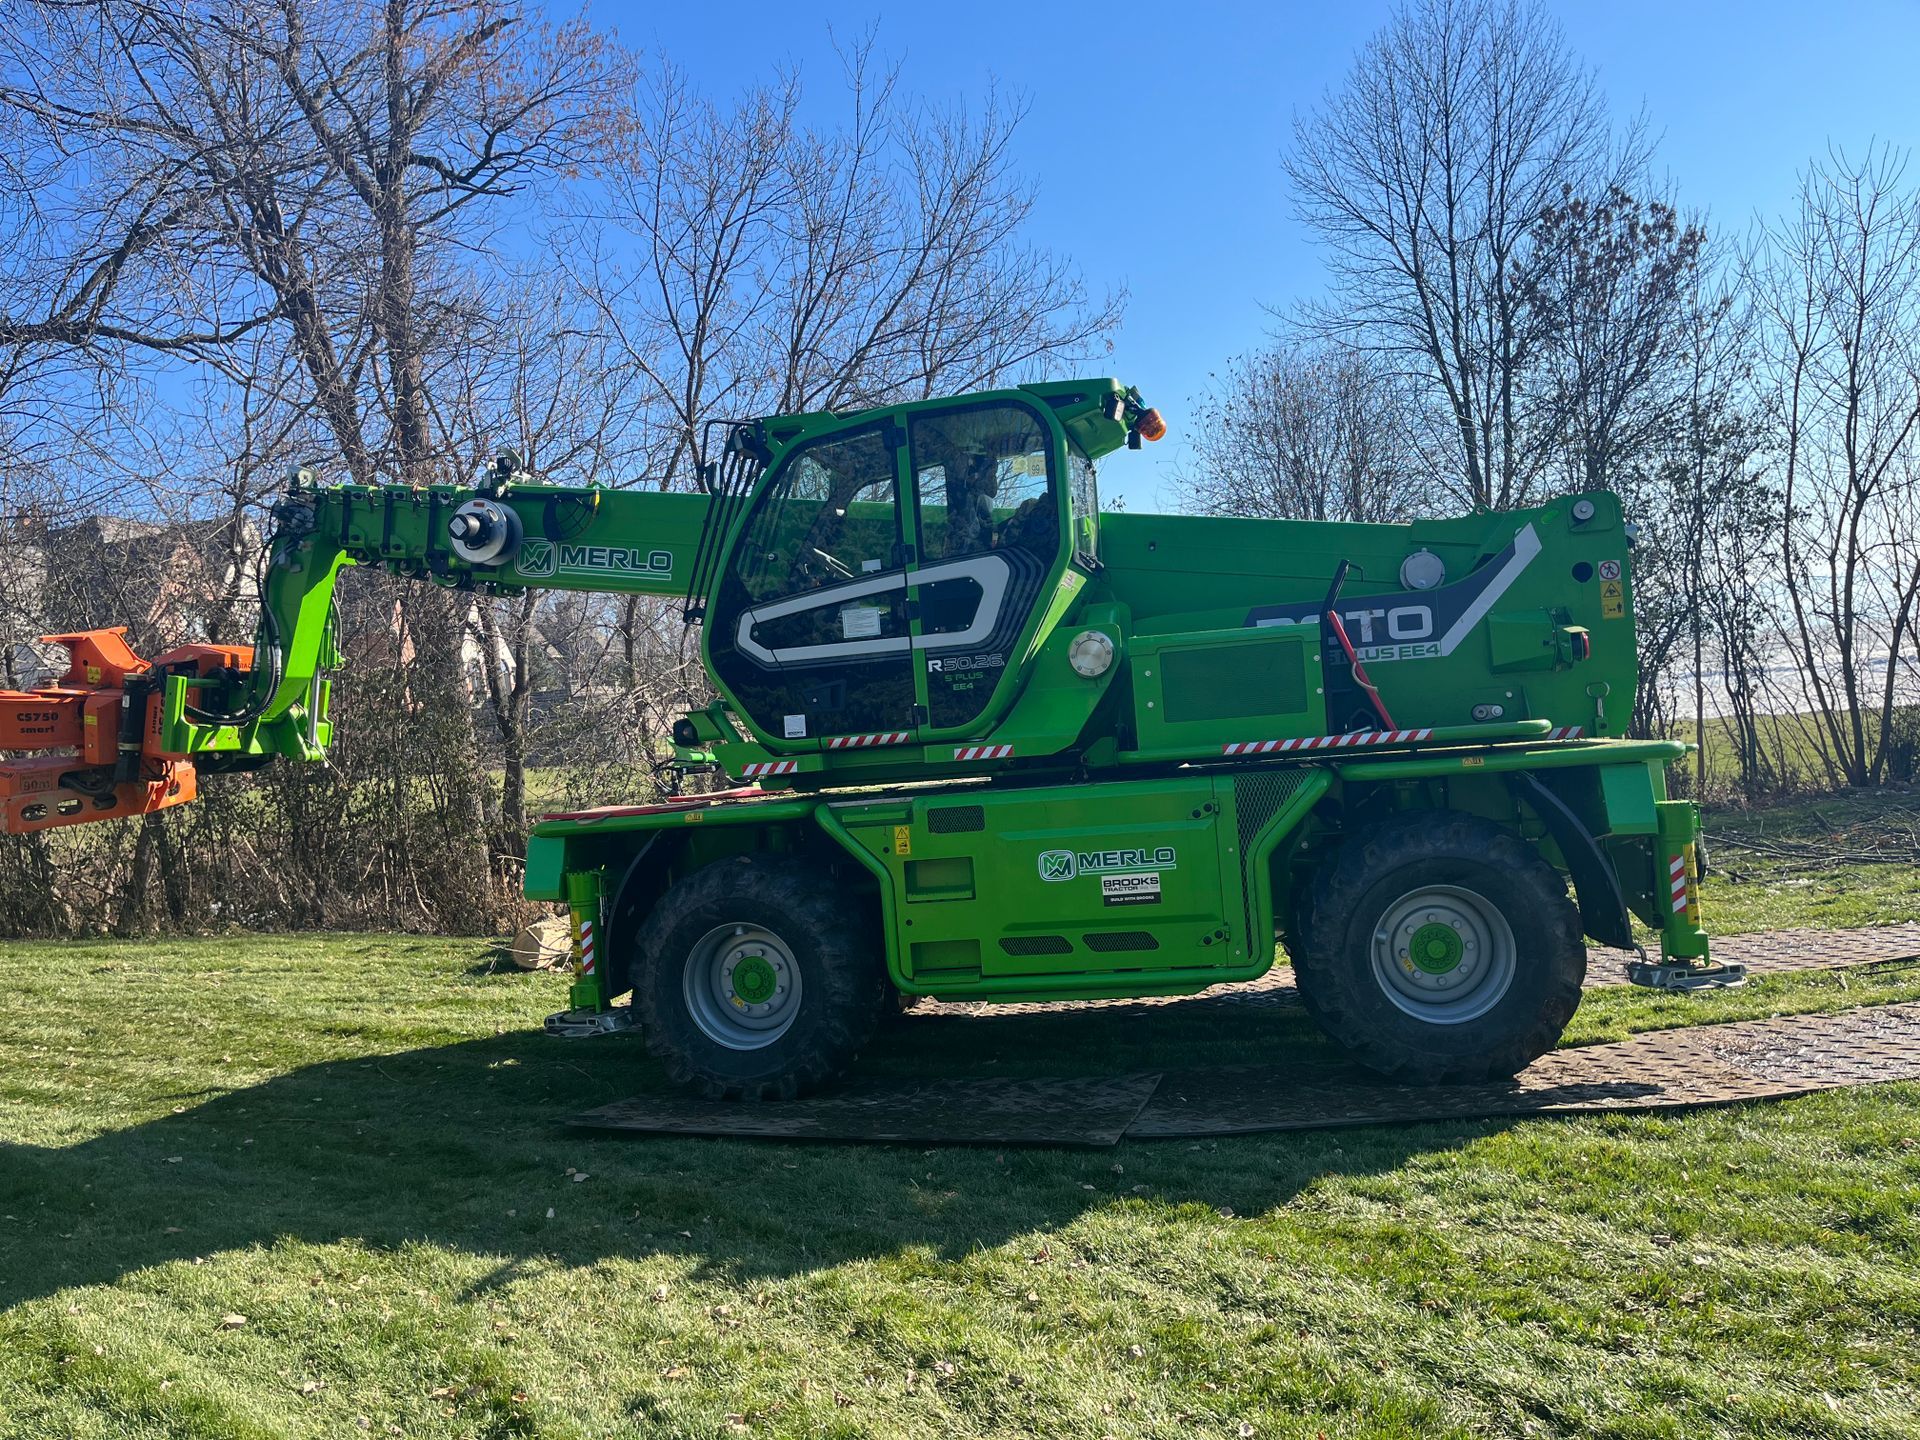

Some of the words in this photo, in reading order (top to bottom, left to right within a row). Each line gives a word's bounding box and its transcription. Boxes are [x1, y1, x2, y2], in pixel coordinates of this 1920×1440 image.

[560, 545, 673, 572] MERLO
[1398, 643, 1440, 658] EE4
[955, 671, 984, 681] PLUS
[952, 682, 974, 691] EE4
[16, 712, 59, 722] CS750
[20, 725, 55, 734] smart
[1078, 847, 1176, 870] MERLO
[1103, 876, 1159, 888] BROOKS
[1103, 885, 1138, 893] TRACTOR
